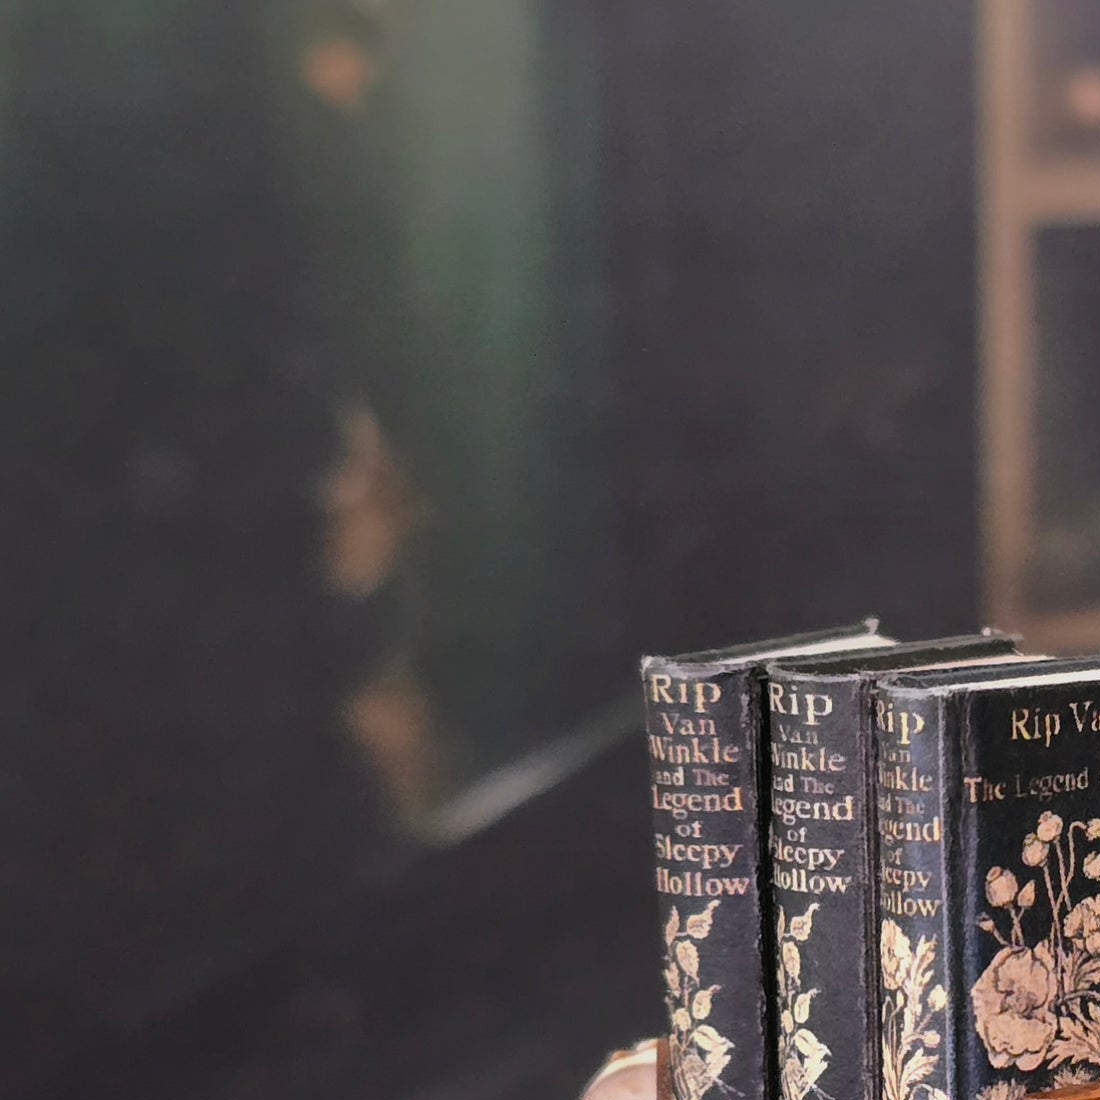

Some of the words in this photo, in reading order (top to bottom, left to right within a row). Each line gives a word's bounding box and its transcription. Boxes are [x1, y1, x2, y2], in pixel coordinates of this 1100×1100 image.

[651, 674, 722, 713] Rip
[768, 681, 833, 726] Rip
[660, 712, 717, 736] Van
[778, 723, 820, 746] Van
[876, 700, 925, 745] Rip
[1010, 707, 1062, 748] Rip
[649, 734, 740, 764] Winkle
[692, 767, 730, 786] The
[963, 775, 1007, 804] The
[1014, 766, 1095, 802] Legend
[651, 783, 744, 820] Legend
[675, 819, 704, 838] of
[786, 826, 808, 844] of
[879, 816, 942, 846] gend
[655, 833, 744, 870] Sleepy
[656, 866, 750, 897] Hollow
[883, 866, 933, 893] eepy
[880, 890, 942, 918] ollow
